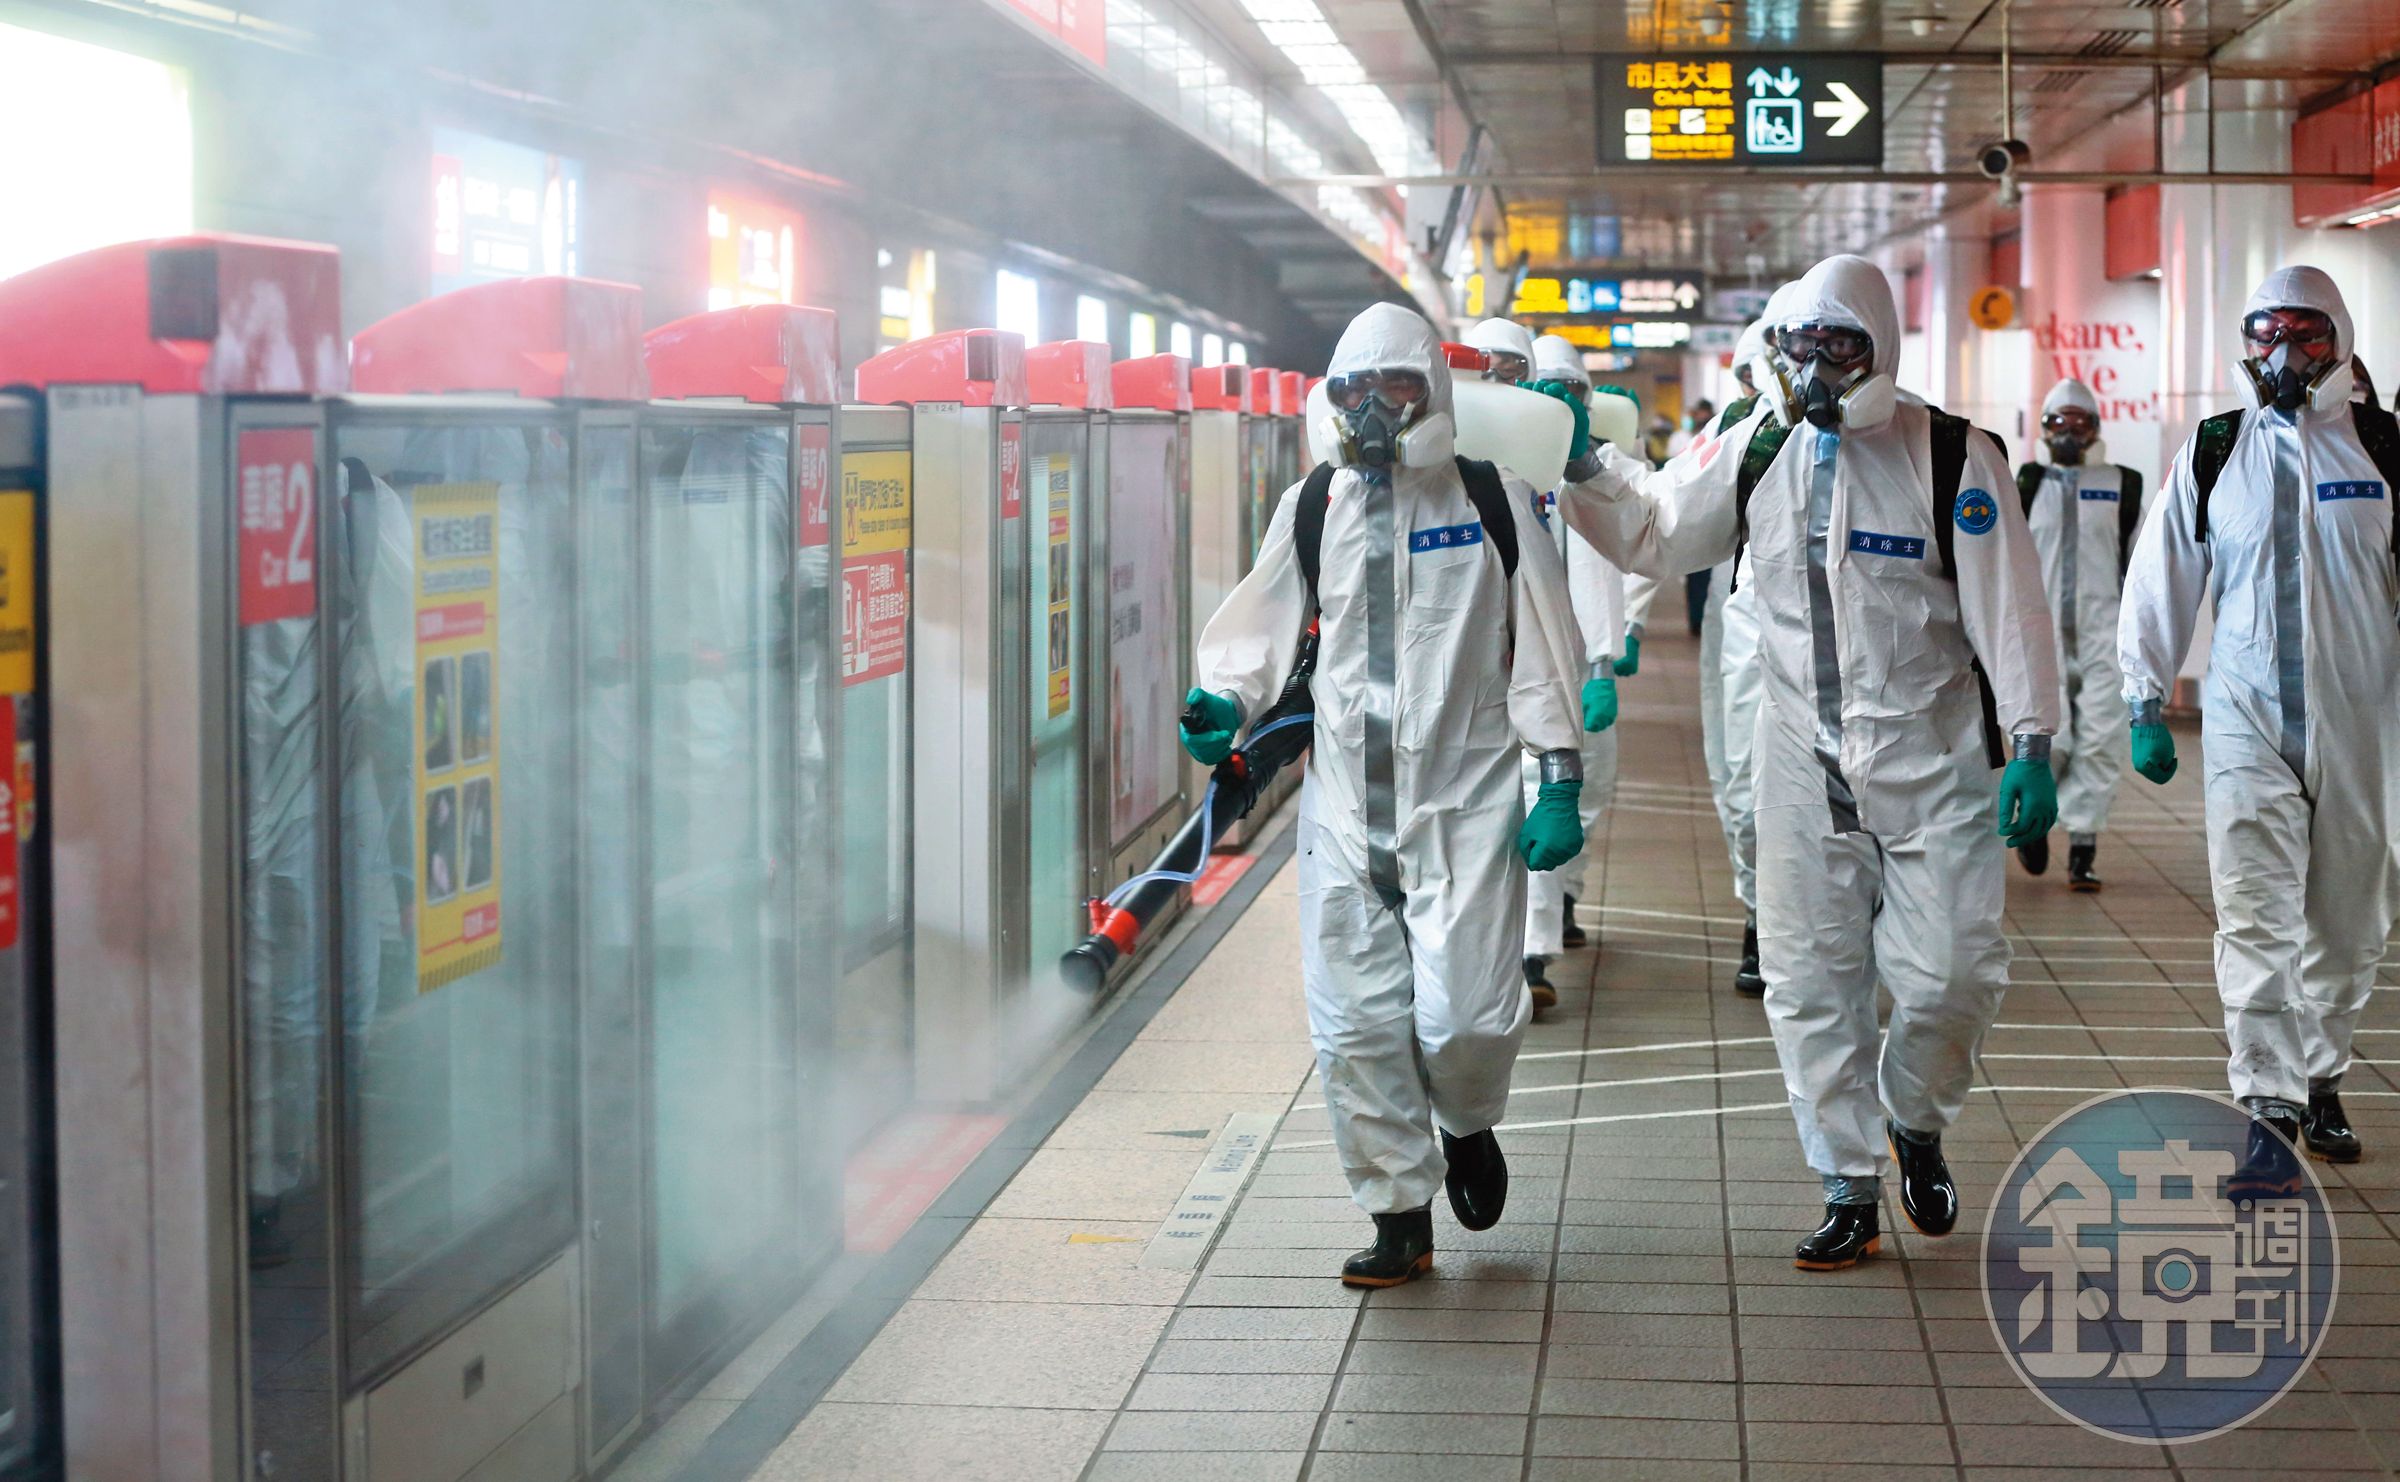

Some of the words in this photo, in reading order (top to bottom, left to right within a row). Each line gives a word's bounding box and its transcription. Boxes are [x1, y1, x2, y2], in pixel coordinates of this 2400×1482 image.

[1627, 62, 1733, 89] 市民大道
[1013, 440, 1020, 499] 2
[817, 448, 828, 523] 2
[2325, 484, 2376, 497] 消除士
[286, 461, 312, 583] 2
[1419, 528, 1472, 547] 消除士
[1858, 535, 1916, 554] 消除士
